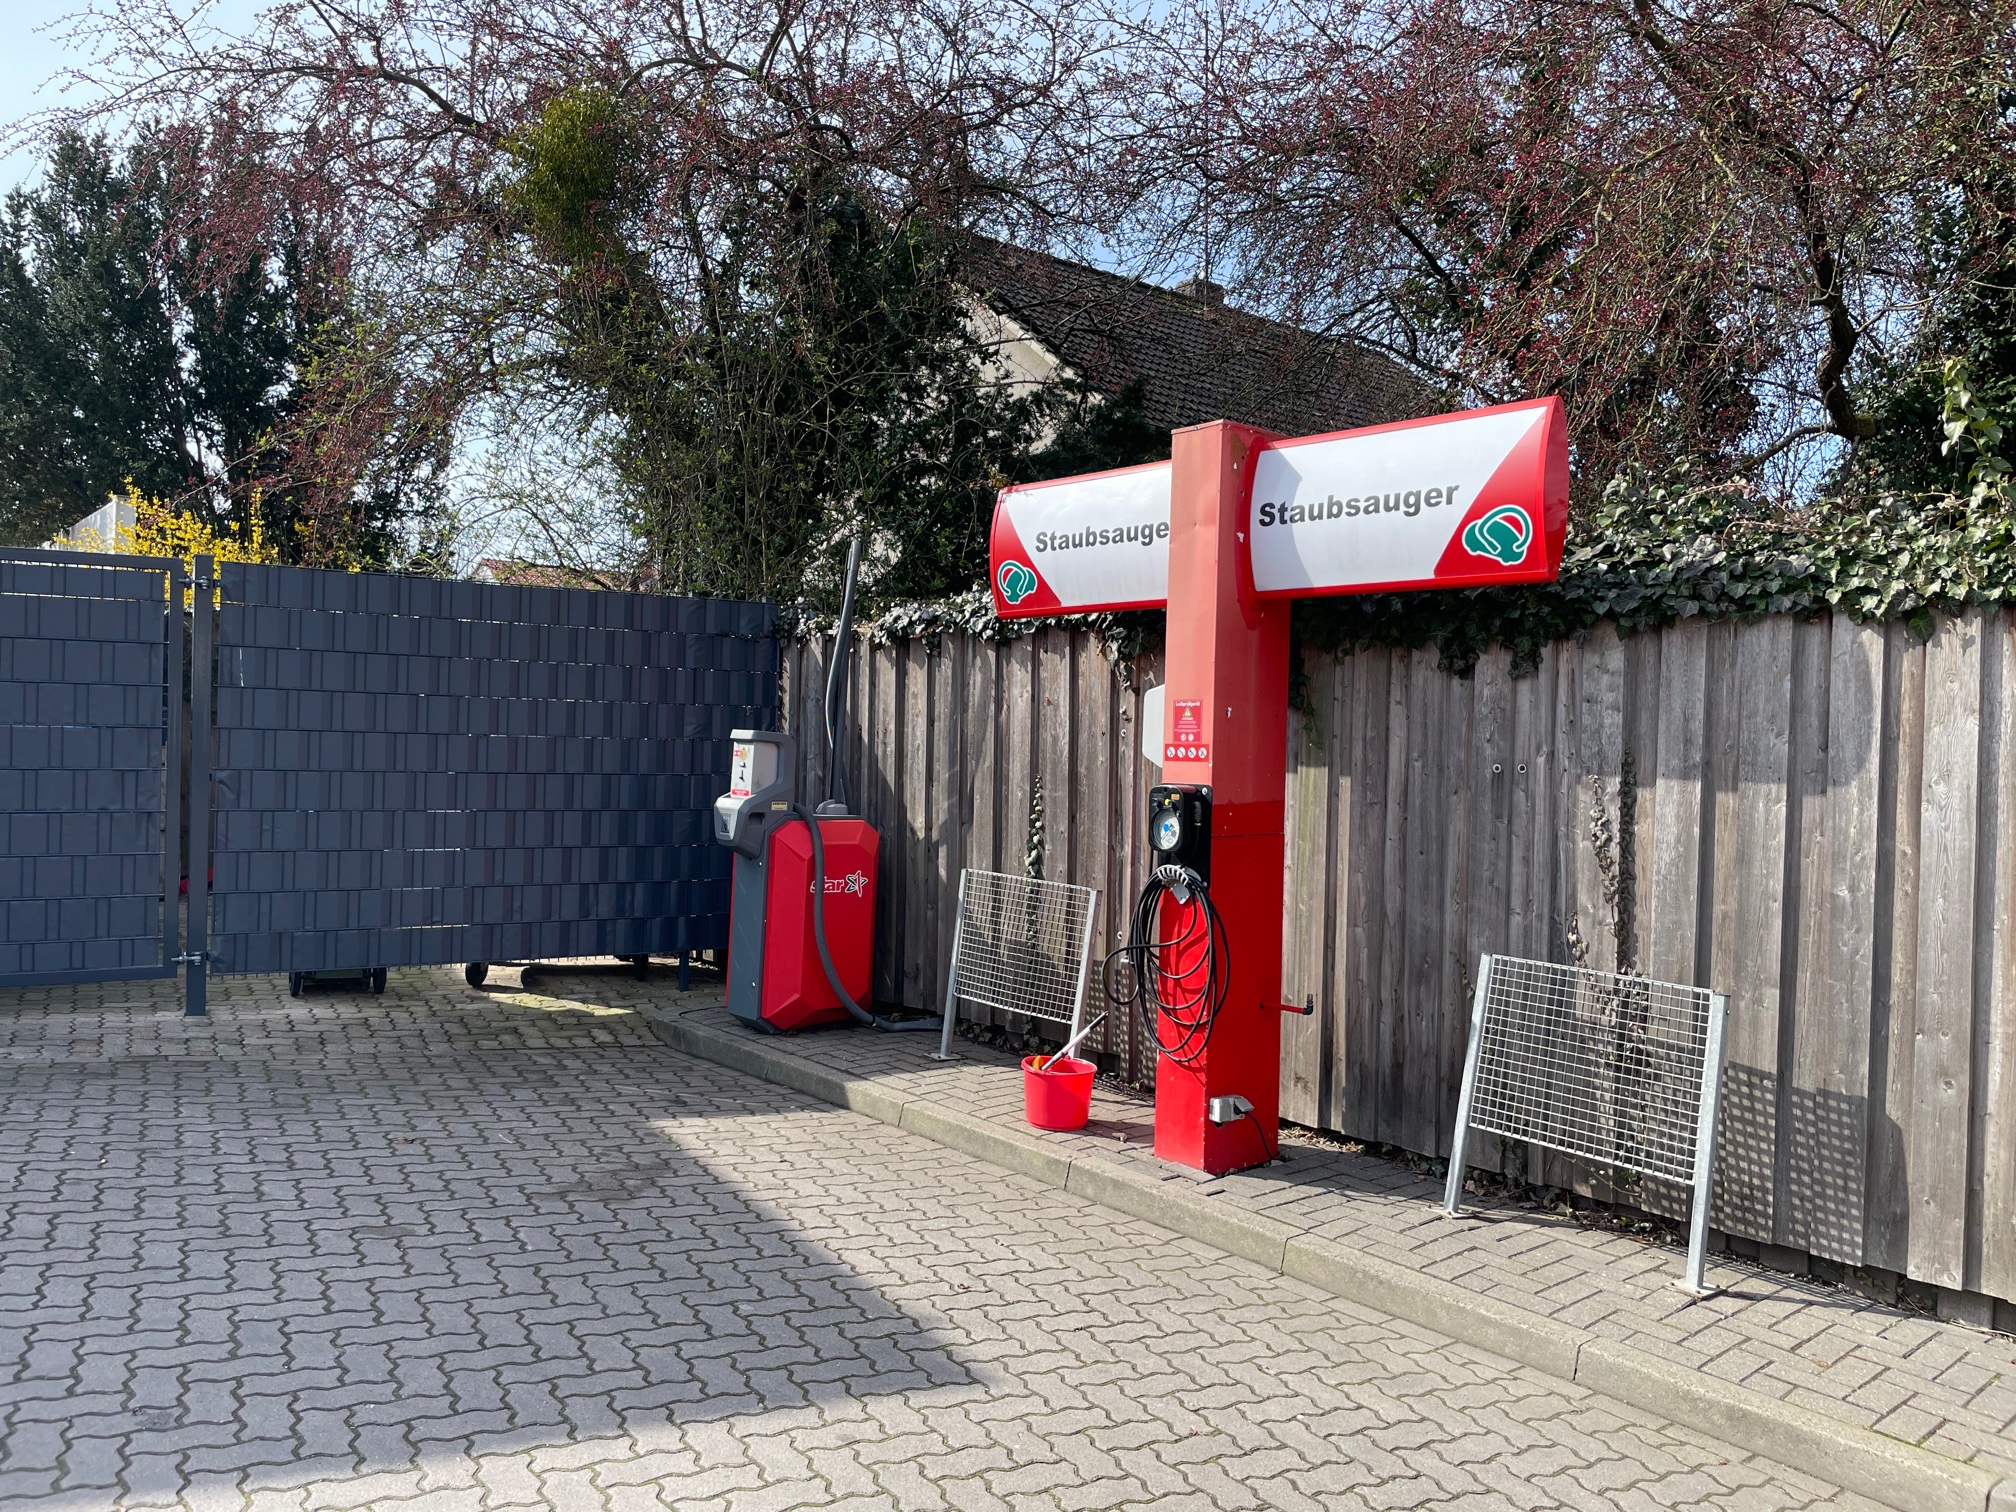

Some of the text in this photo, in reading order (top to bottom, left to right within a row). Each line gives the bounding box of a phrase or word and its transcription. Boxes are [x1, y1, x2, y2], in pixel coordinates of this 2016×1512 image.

[1258, 484, 1460, 527] Staubsauger
[1035, 521, 1169, 552] Staubsauge
[810, 876, 845, 893] sar
